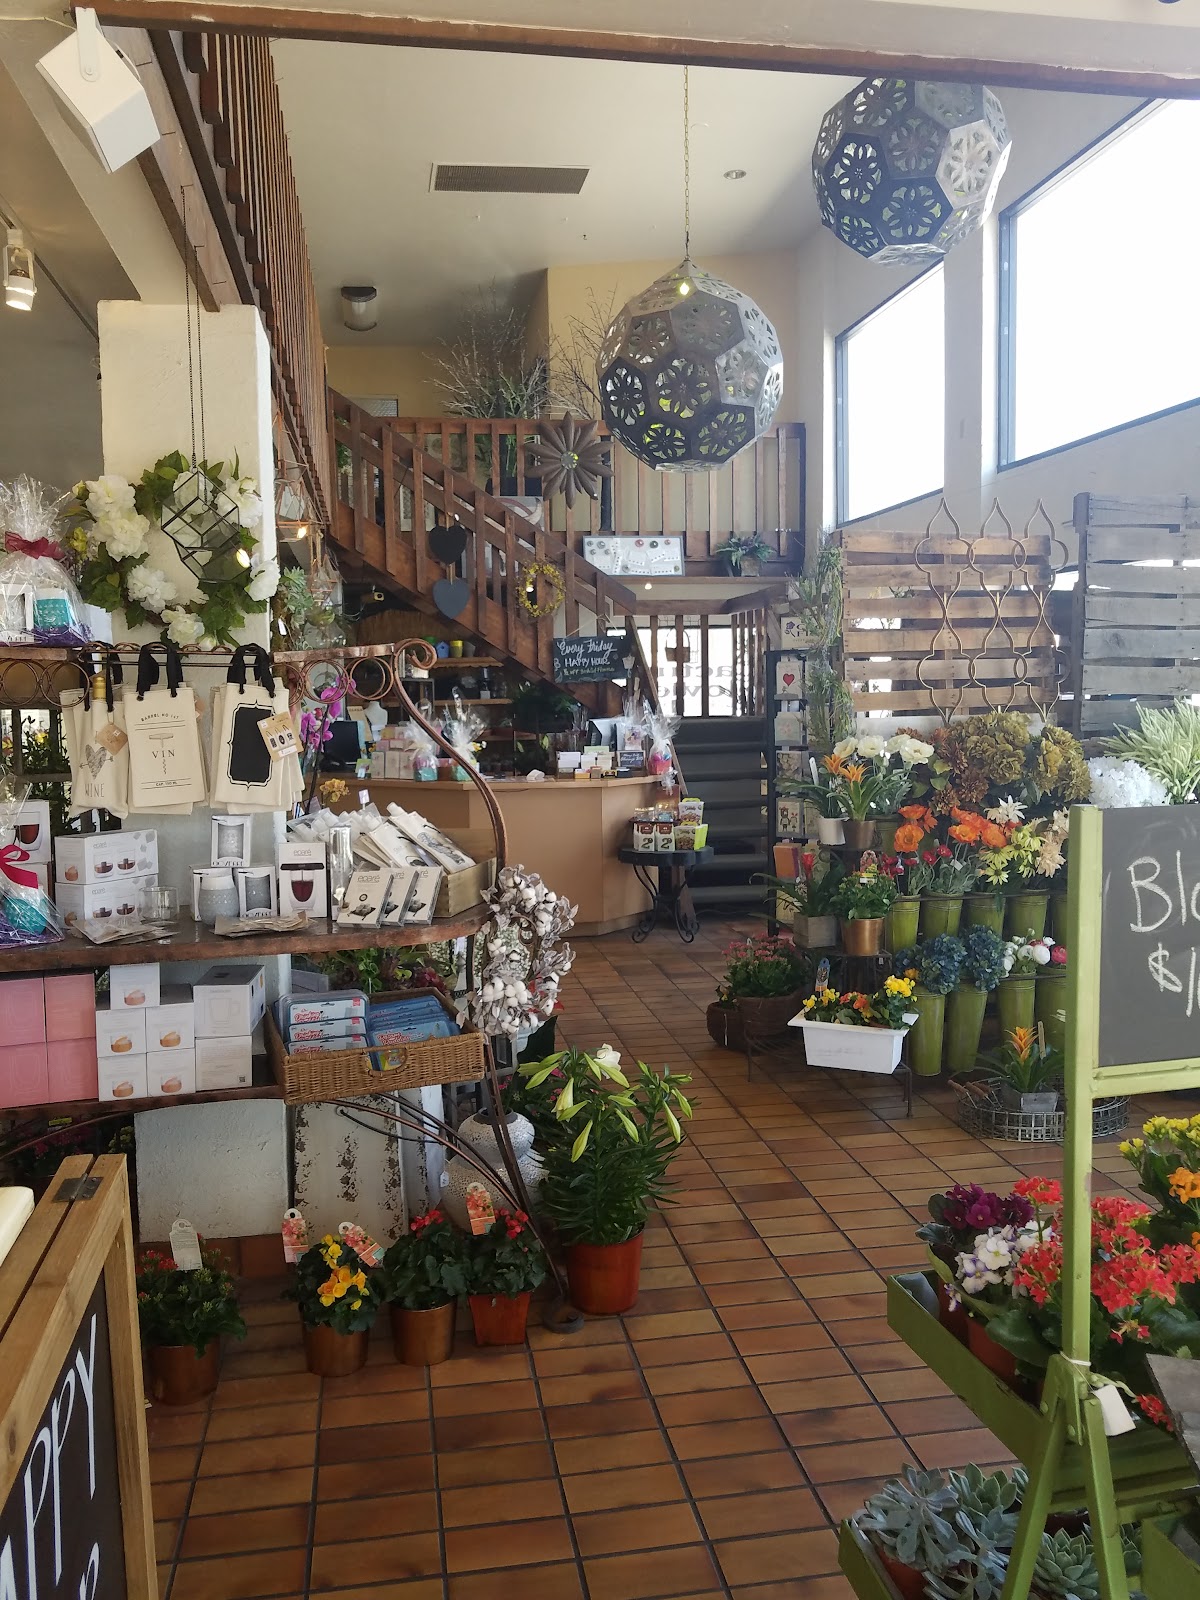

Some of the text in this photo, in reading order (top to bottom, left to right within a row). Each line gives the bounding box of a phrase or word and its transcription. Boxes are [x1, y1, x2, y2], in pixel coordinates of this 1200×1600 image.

[557, 639, 617, 660] Every Friday
[565, 657, 589, 668] HAPPY
[141, 713, 160, 722] BARREL
[151, 749, 176, 759] VIN
[84, 783, 105, 798] WINE
[1147, 942, 1200, 1018] $1
